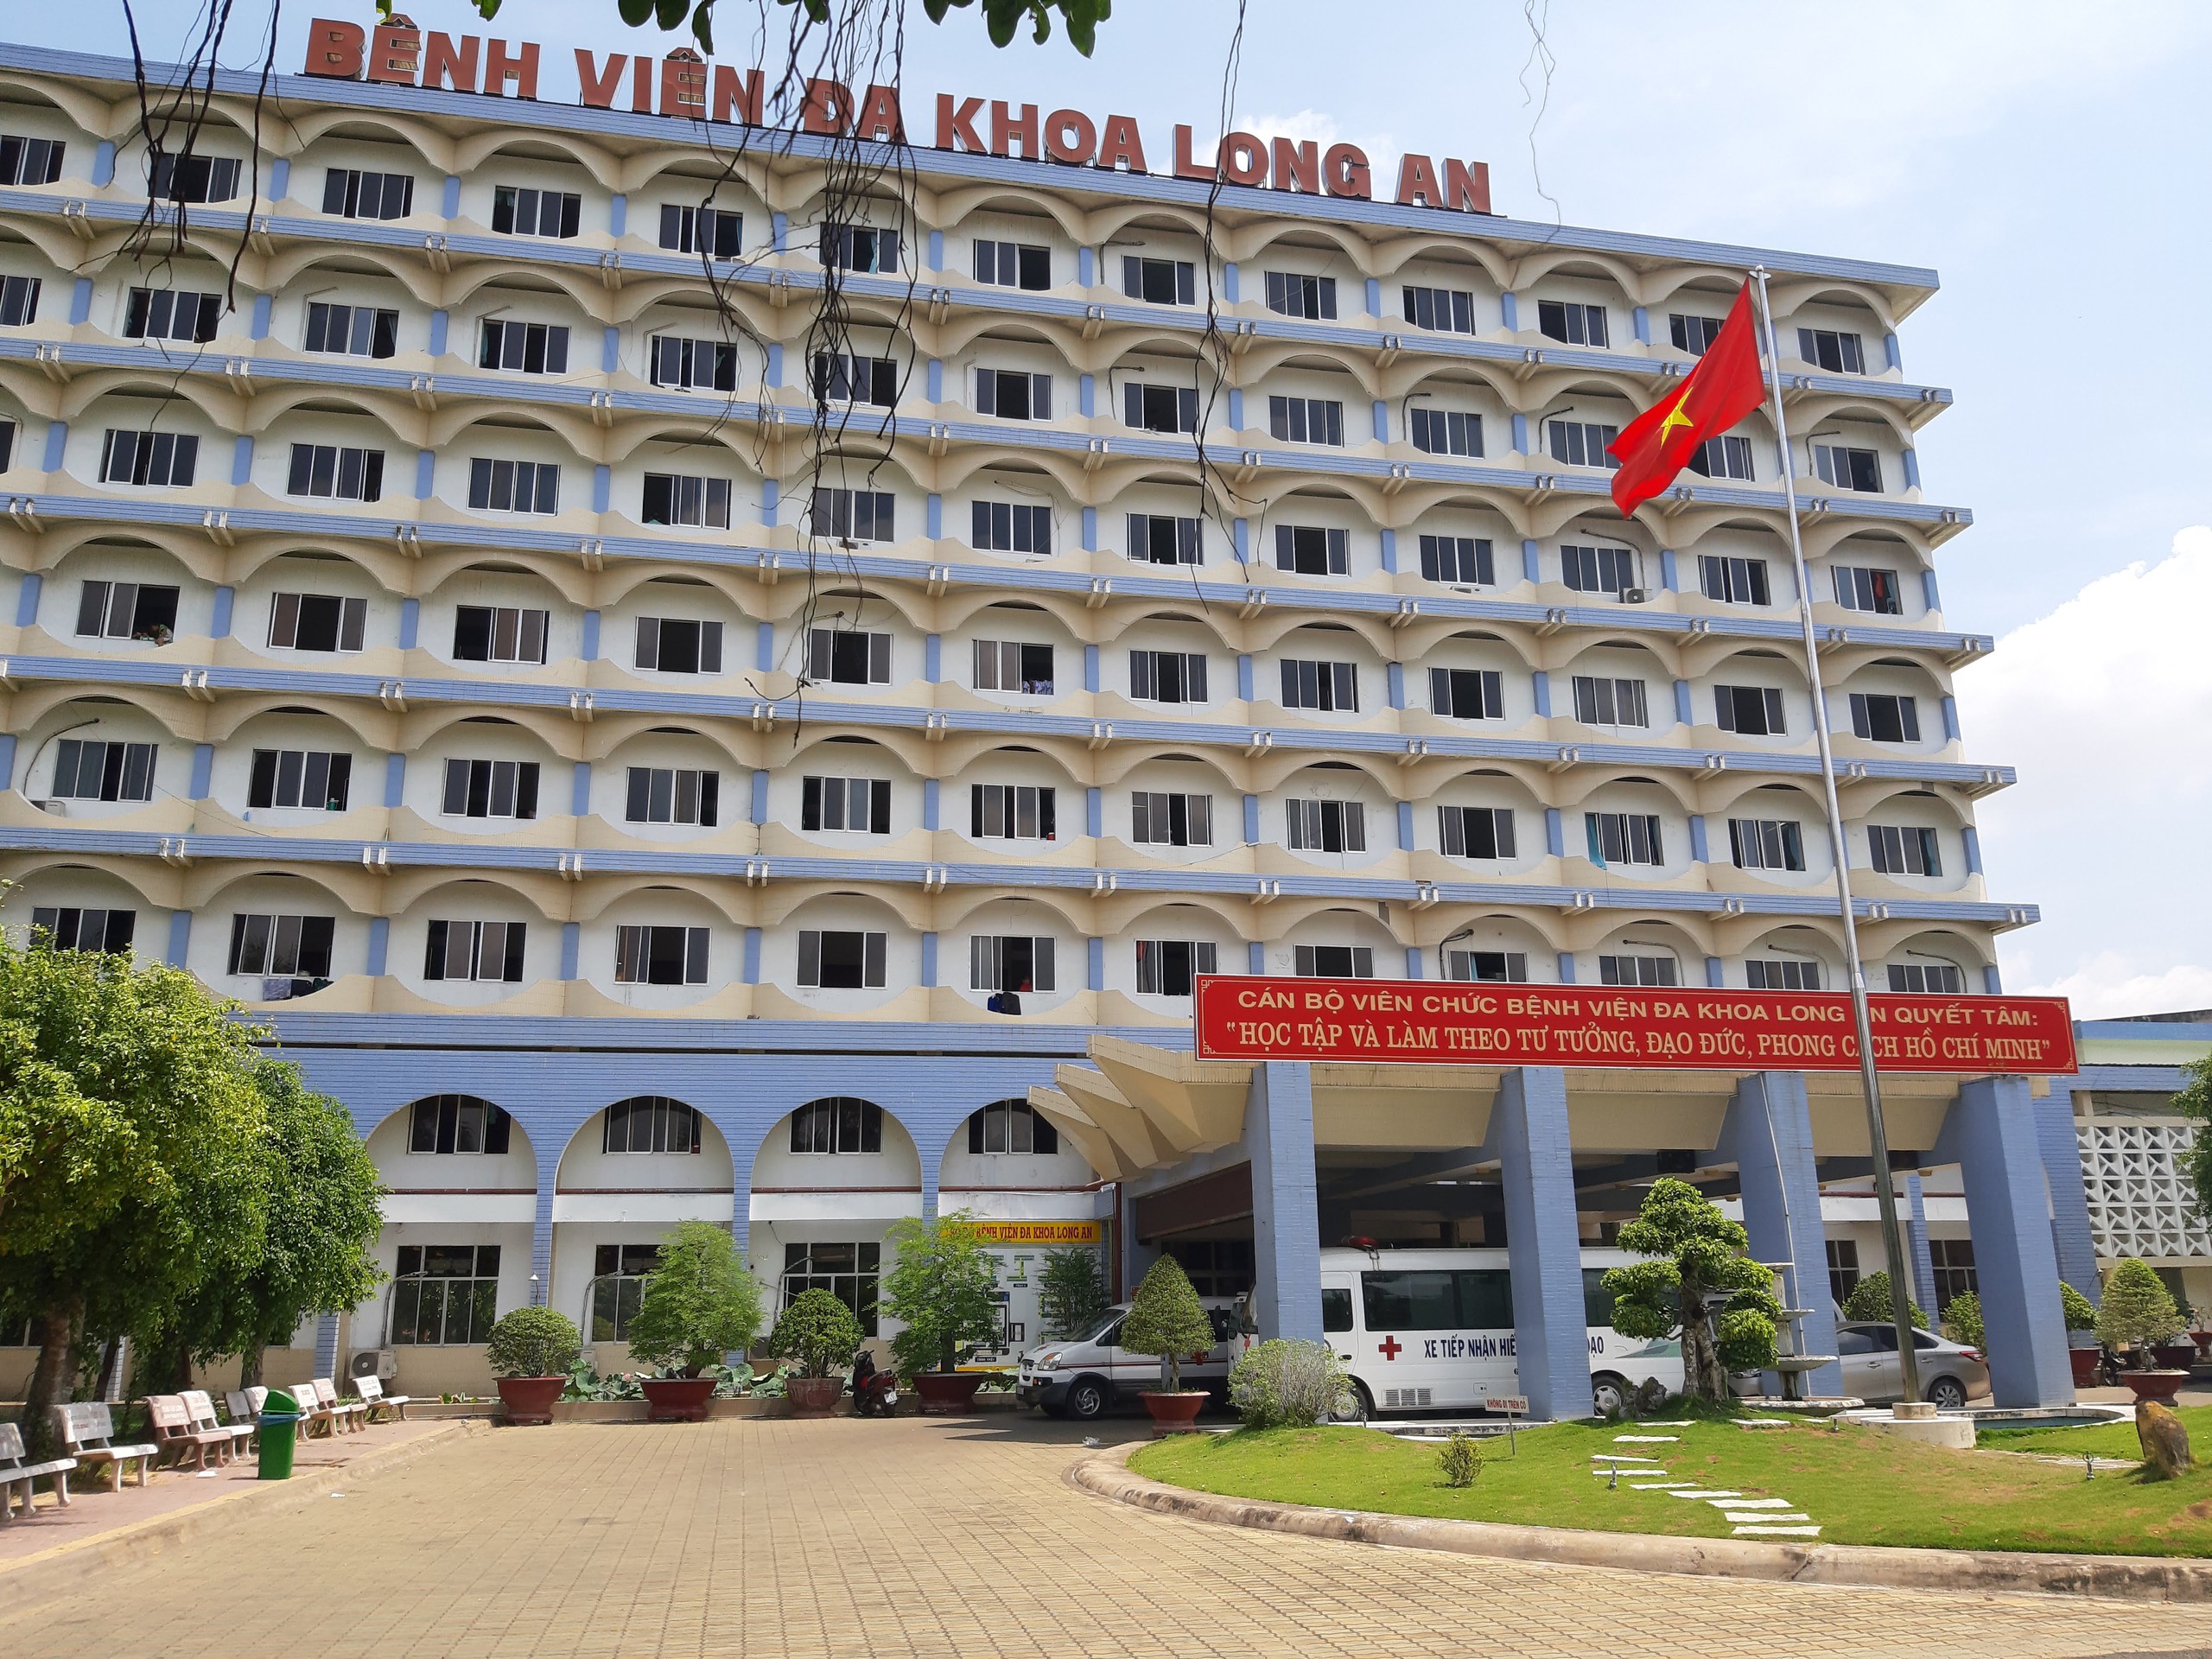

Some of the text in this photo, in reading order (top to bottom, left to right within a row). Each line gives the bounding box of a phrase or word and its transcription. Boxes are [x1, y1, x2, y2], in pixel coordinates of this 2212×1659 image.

[799, 77, 906, 145] ĐA
[936, 92, 1147, 172] KHOA
[1172, 123, 1371, 200] LONG
[1393, 152, 1492, 214] AN
[1237, 987, 1295, 1009] CÁN
[1305, 988, 1344, 1014] BỘ
[1351, 990, 1413, 1012] VIÊN
[1422, 992, 1498, 1014] CHỨC
[1507, 995, 1580, 1019] BỆNH
[1587, 997, 1648, 1021] VIỆN
[1653, 1001, 1690, 1019] ĐA
[1697, 1002, 1770, 1020] KHOA
[1776, 1004, 1846, 1023] LONG
[1894, 1002, 1975, 1025] QUYẾT
[1980, 1006, 2039, 1027] TÂM:
[1298, 1017, 1343, 1052] TẬP
[1348, 1019, 1381, 1048] VÀ
[1386, 1020, 1439, 1050] LÀM
[1445, 1027, 1511, 1052] THEO
[1516, 1025, 1549, 1052] TƯ
[1554, 1020, 1641, 1058] TƯỞNG,
[1645, 1031, 1694, 1059] ĐẠO
[1698, 1027, 1753, 1059] ĐỨC,
[1756, 1033, 1837, 1058] PHONG
[1841, 1034, 1901, 1058] CCH
[1904, 1027, 1937, 1059] HỒ
[1942, 1032, 1981, 1058] CHÍ
[1020, 1226, 1032, 1239] ĐA
[1033, 1226, 1055, 1239] KHOA
[1056, 1226, 1080, 1239] LONG
[1081, 1226, 1093, 1239] AN
[1424, 1339, 1438, 1358] XE
[1440, 1333, 1465, 1358] TIẾP
[1468, 1335, 1497, 1361] NHẬN
[1586, 1336, 1605, 1358] ẠO
[1486, 1397, 1503, 1408] KHÔNG
[1508, 1397, 1520, 1409] TRÊN
